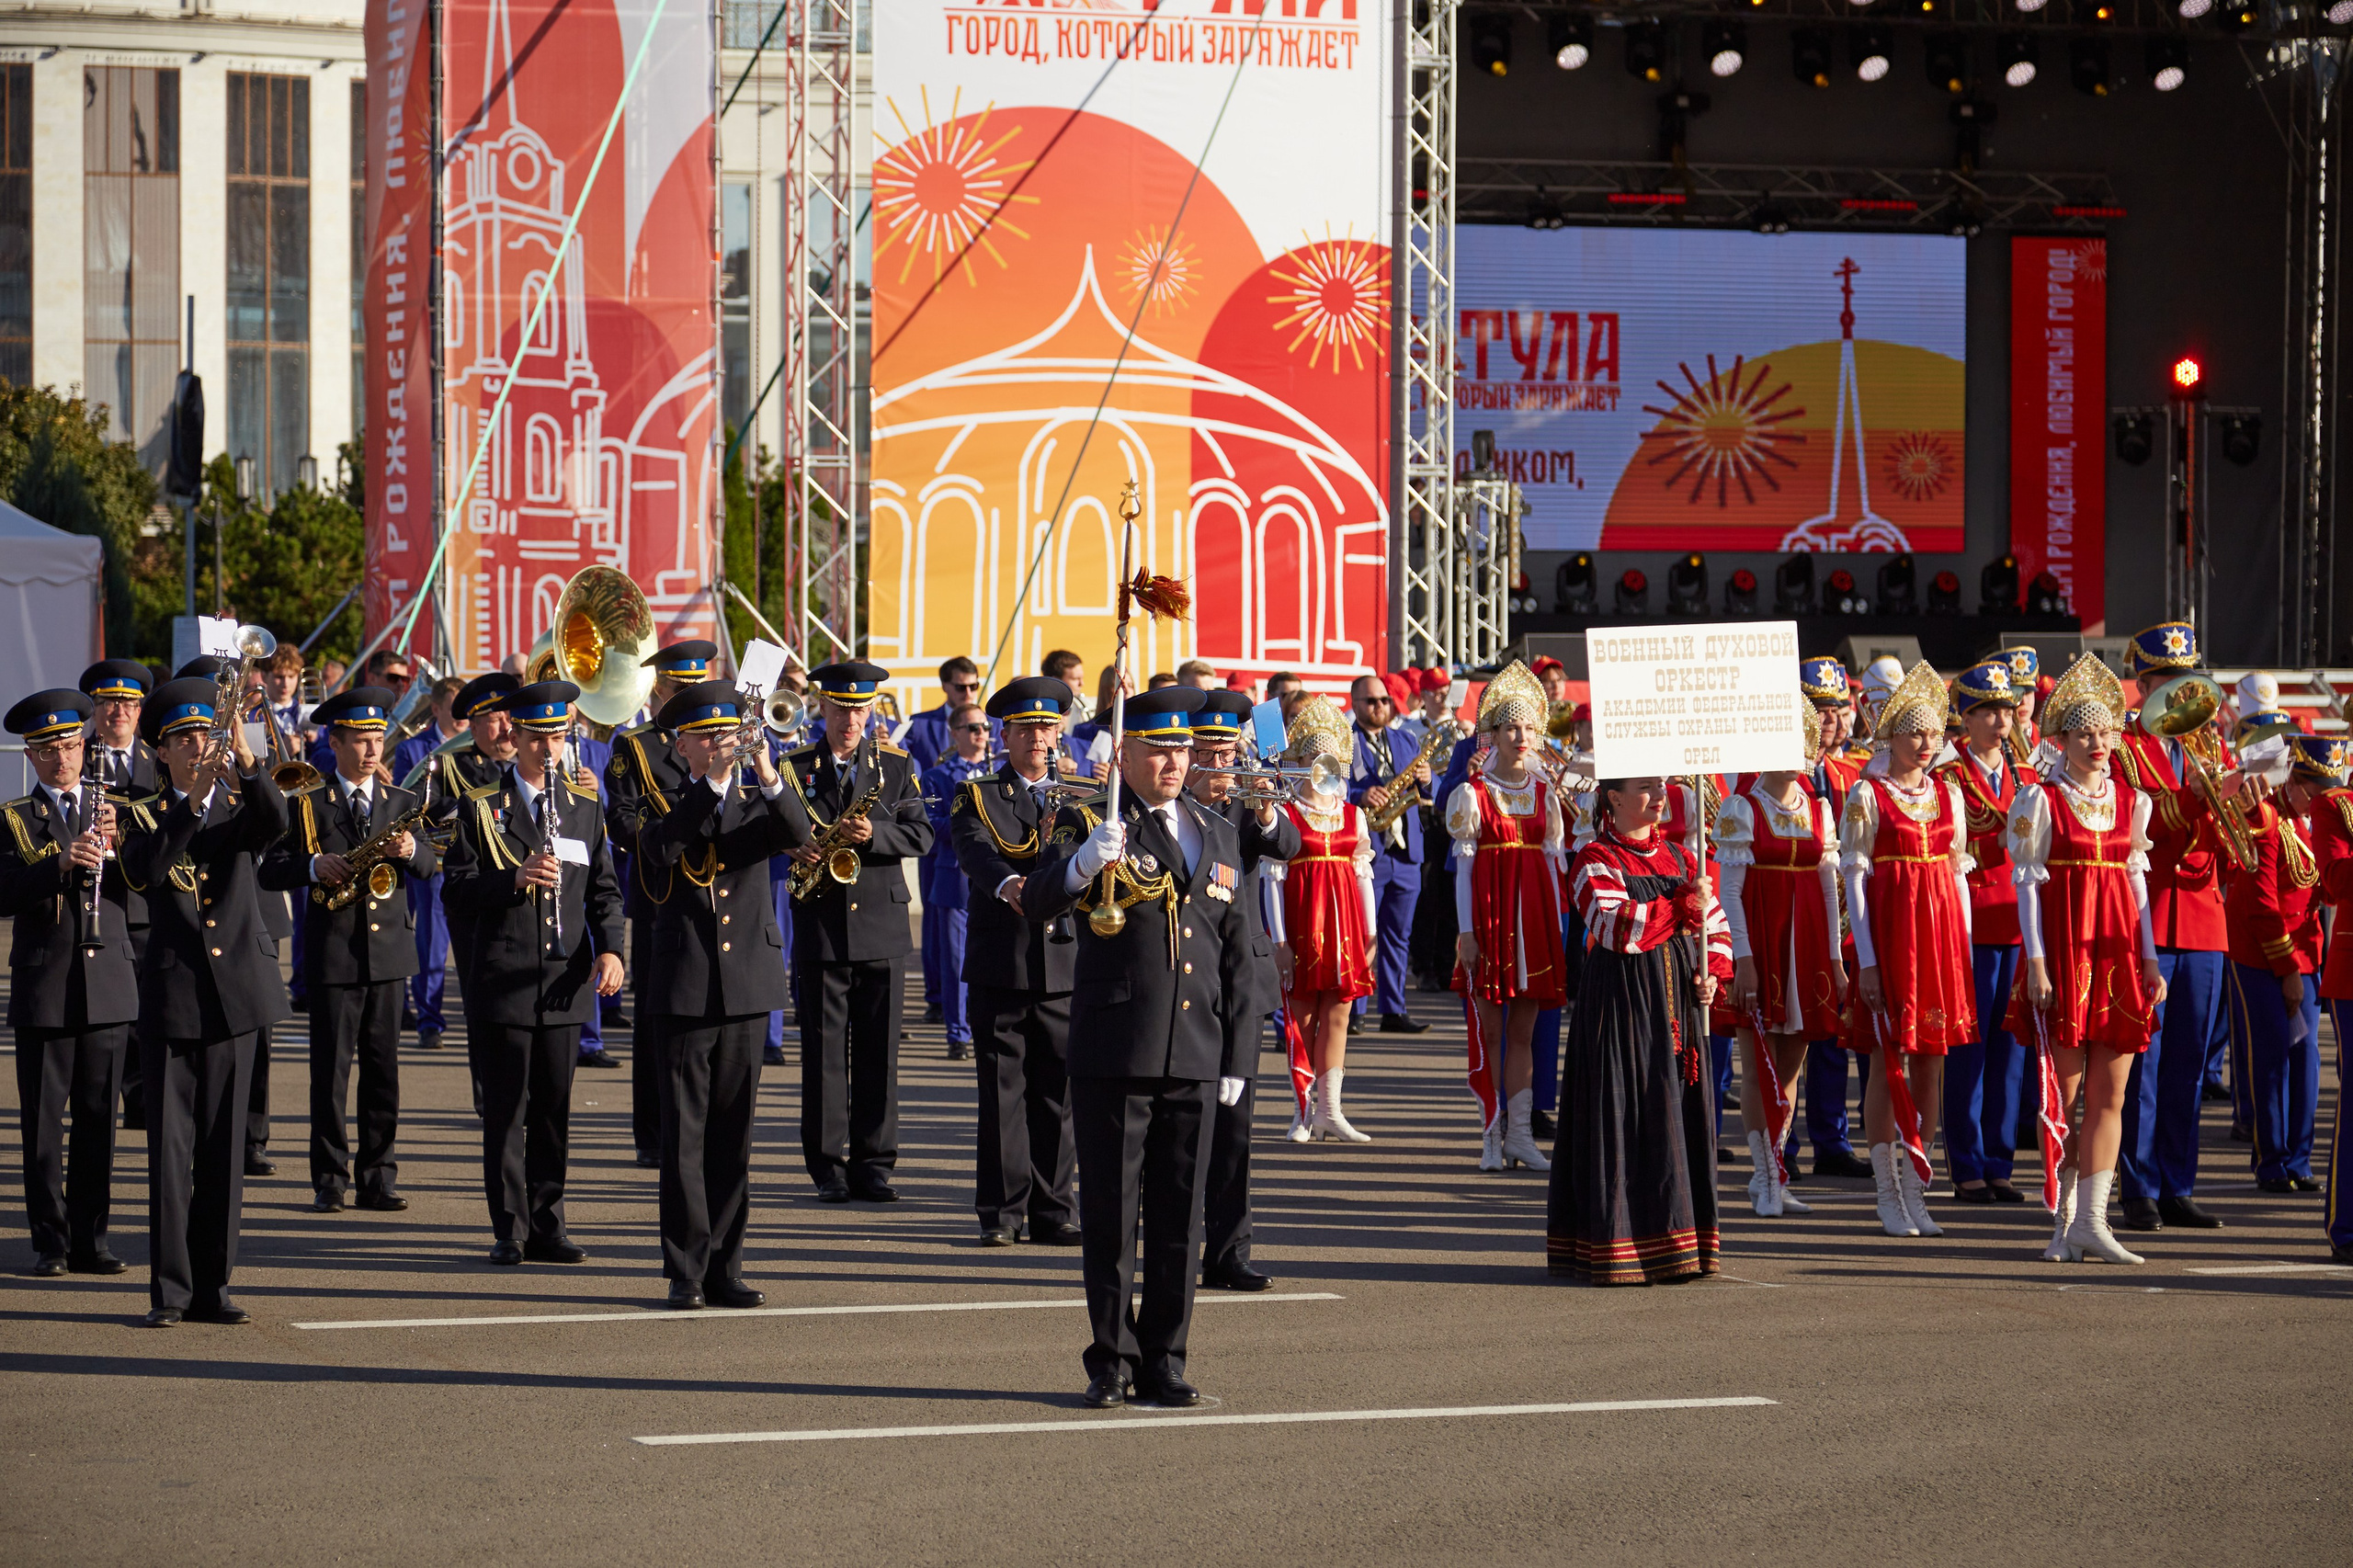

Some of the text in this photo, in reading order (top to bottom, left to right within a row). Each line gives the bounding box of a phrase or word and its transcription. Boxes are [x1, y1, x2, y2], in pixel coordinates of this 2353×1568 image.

[945, 15, 1360, 70] ГОРОД, КОТОРЫЙ ЗАРЯЖАЕТ
[2047, 248, 2077, 322] ГОРОД!
[1460, 310, 1620, 382] ТУЛА
[2045, 327, 2075, 434] ЛЮБИМЫЙ
[1515, 384, 1621, 412] ЗАРЯЖАЕТ
[2047, 441, 2077, 558] РОЖДЕНИЯ,
[1593, 631, 1795, 664] ВОЕННЫЙ ДУХОВОЙ
[1654, 665, 1740, 692] ОРКЕСТР
[1603, 692, 1792, 718] АКАДЕМИИ ФЕДЕРАЛЬНОЙ
[1605, 715, 1793, 739] СЛУЖБЫ ОХРАНЫ РОССИИ
[1684, 746, 1721, 765] ОРЕЛ
